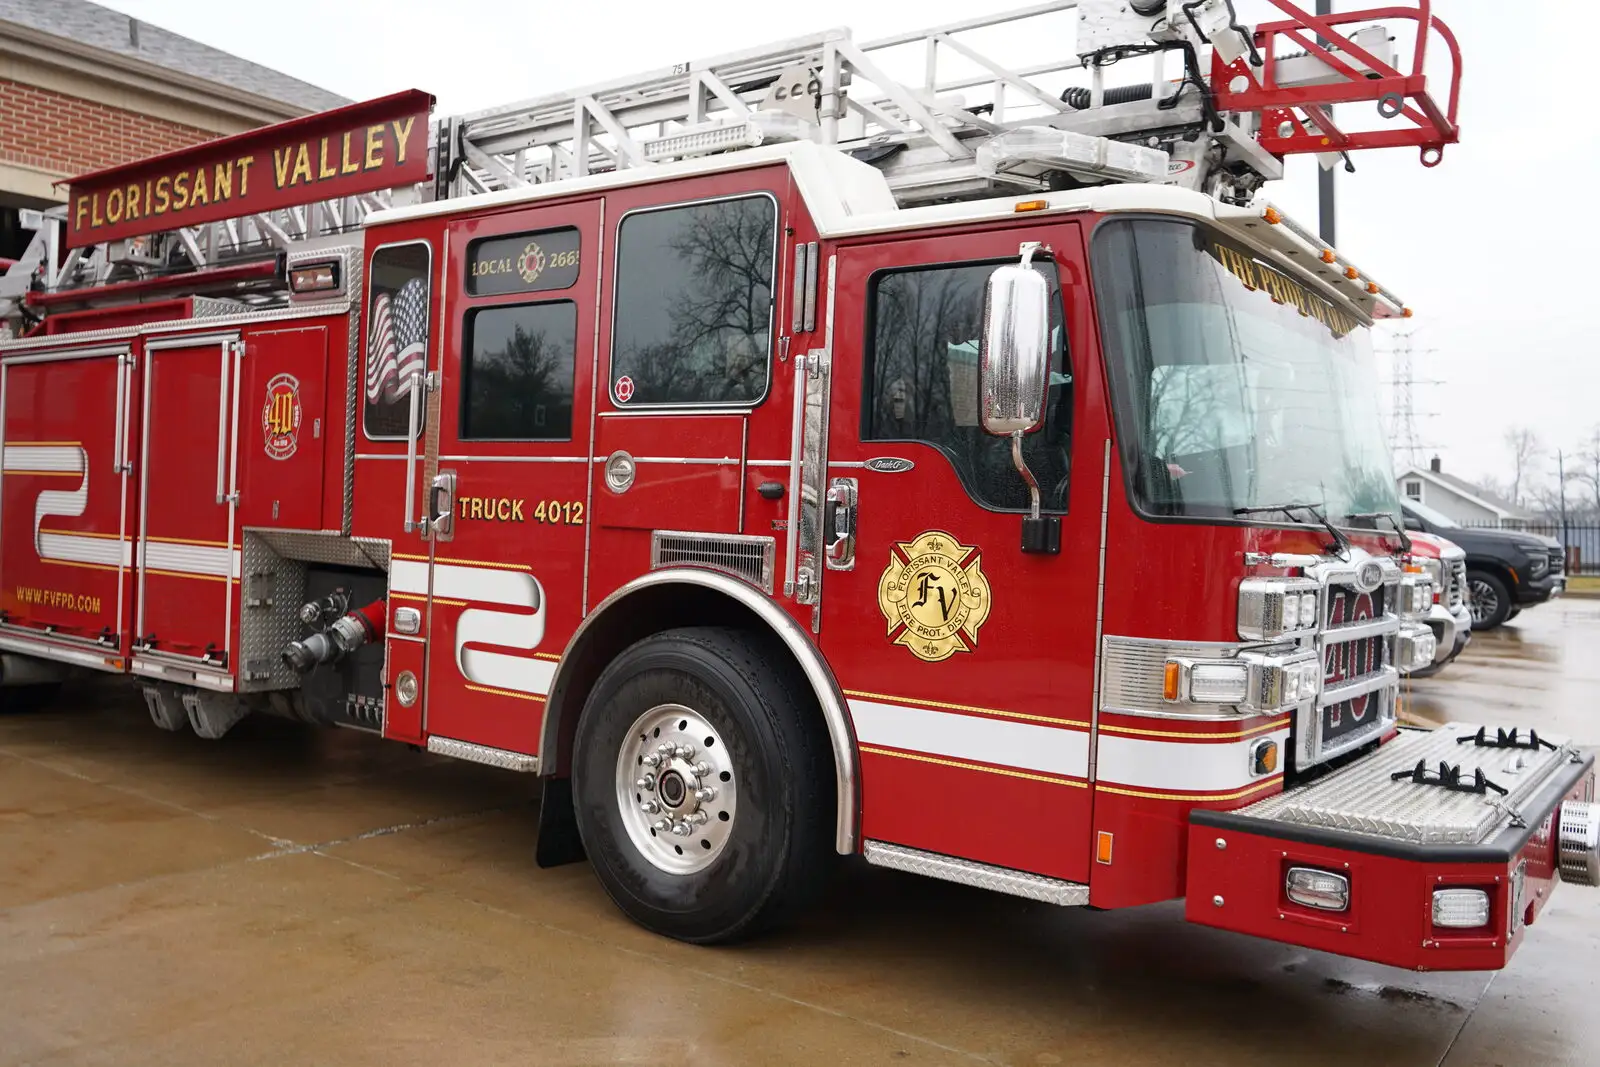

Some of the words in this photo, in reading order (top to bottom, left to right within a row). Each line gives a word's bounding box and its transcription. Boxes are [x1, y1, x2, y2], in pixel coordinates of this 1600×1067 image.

[672, 63, 683, 75] 75
[74, 156, 254, 231] FLORISSANT
[273, 116, 416, 189] VALLEY
[472, 258, 513, 276] LOCAL
[269, 392, 293, 433] 40
[458, 497, 524, 521] TRUCK
[533, 500, 584, 525] 4012
[898, 555, 944, 592] FLORISSANT
[946, 560, 970, 597] VALLEY
[16, 585, 101, 614] WWW.FVFPD.COM
[899, 603, 916, 627] FIRE
[916, 625, 945, 638] PROT.
[947, 609, 968, 632] DIST.
